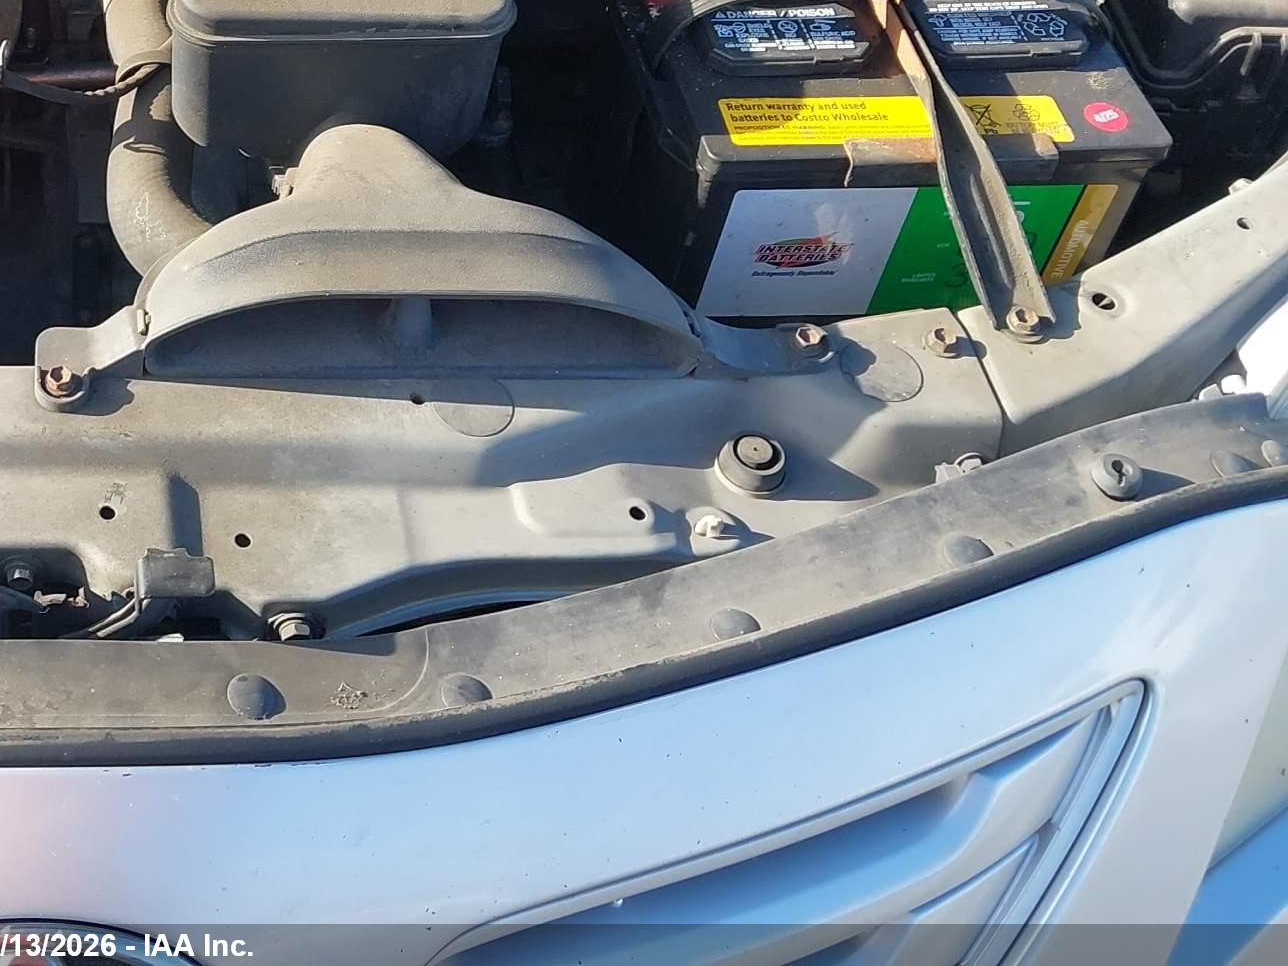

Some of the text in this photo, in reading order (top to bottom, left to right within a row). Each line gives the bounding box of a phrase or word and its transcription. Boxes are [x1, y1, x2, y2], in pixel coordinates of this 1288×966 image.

[726, 10, 776, 19] DANGER
[788, 8, 836, 18] POISON
[726, 101, 866, 114] Return warranty and used
[730, 112, 889, 123] batteries to Costco Wholesale
[756, 243, 849, 254] INTERSTATE
[1051, 219, 1090, 279] AUTOMOTIVE
[755, 253, 842, 263] BATTERIES
